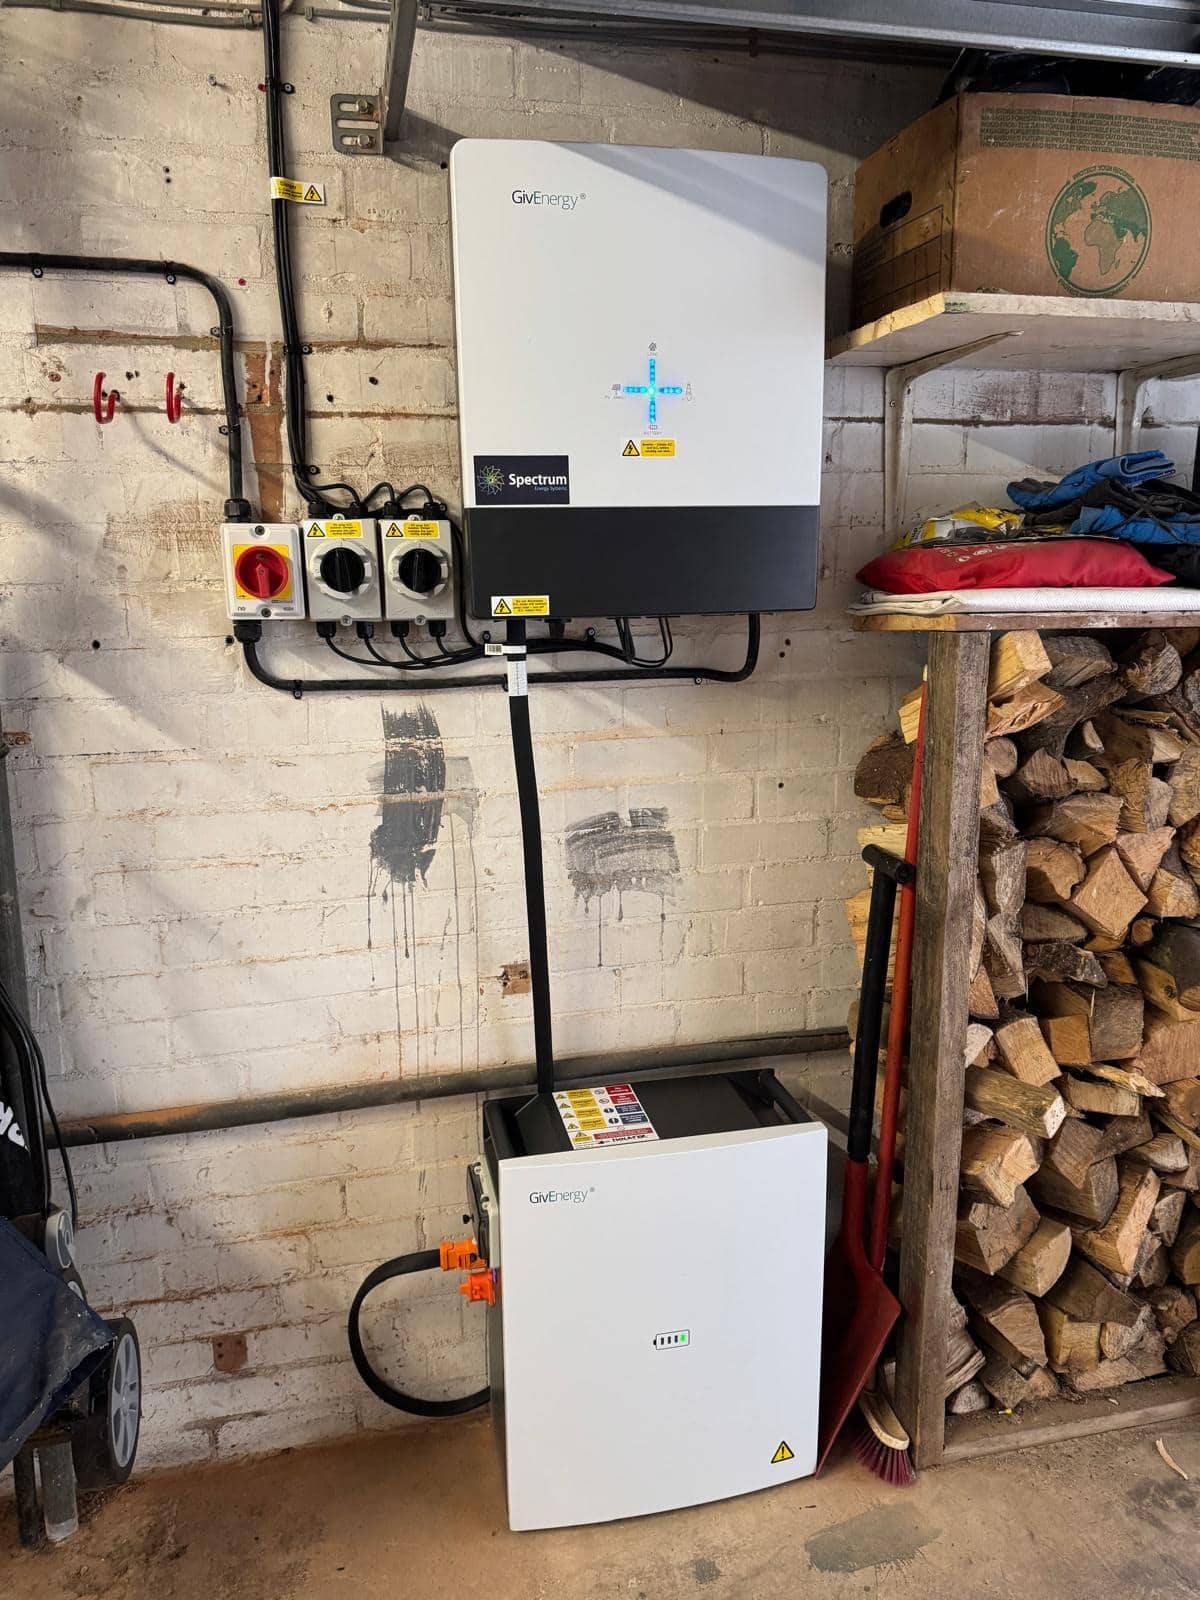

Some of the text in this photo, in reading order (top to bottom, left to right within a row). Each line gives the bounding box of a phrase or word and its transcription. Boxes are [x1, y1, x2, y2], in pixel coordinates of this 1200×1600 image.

[512, 190, 578, 210] GivEnergy
[508, 473, 567, 488] Spectrum
[529, 1190, 588, 1204] GivEnergy
